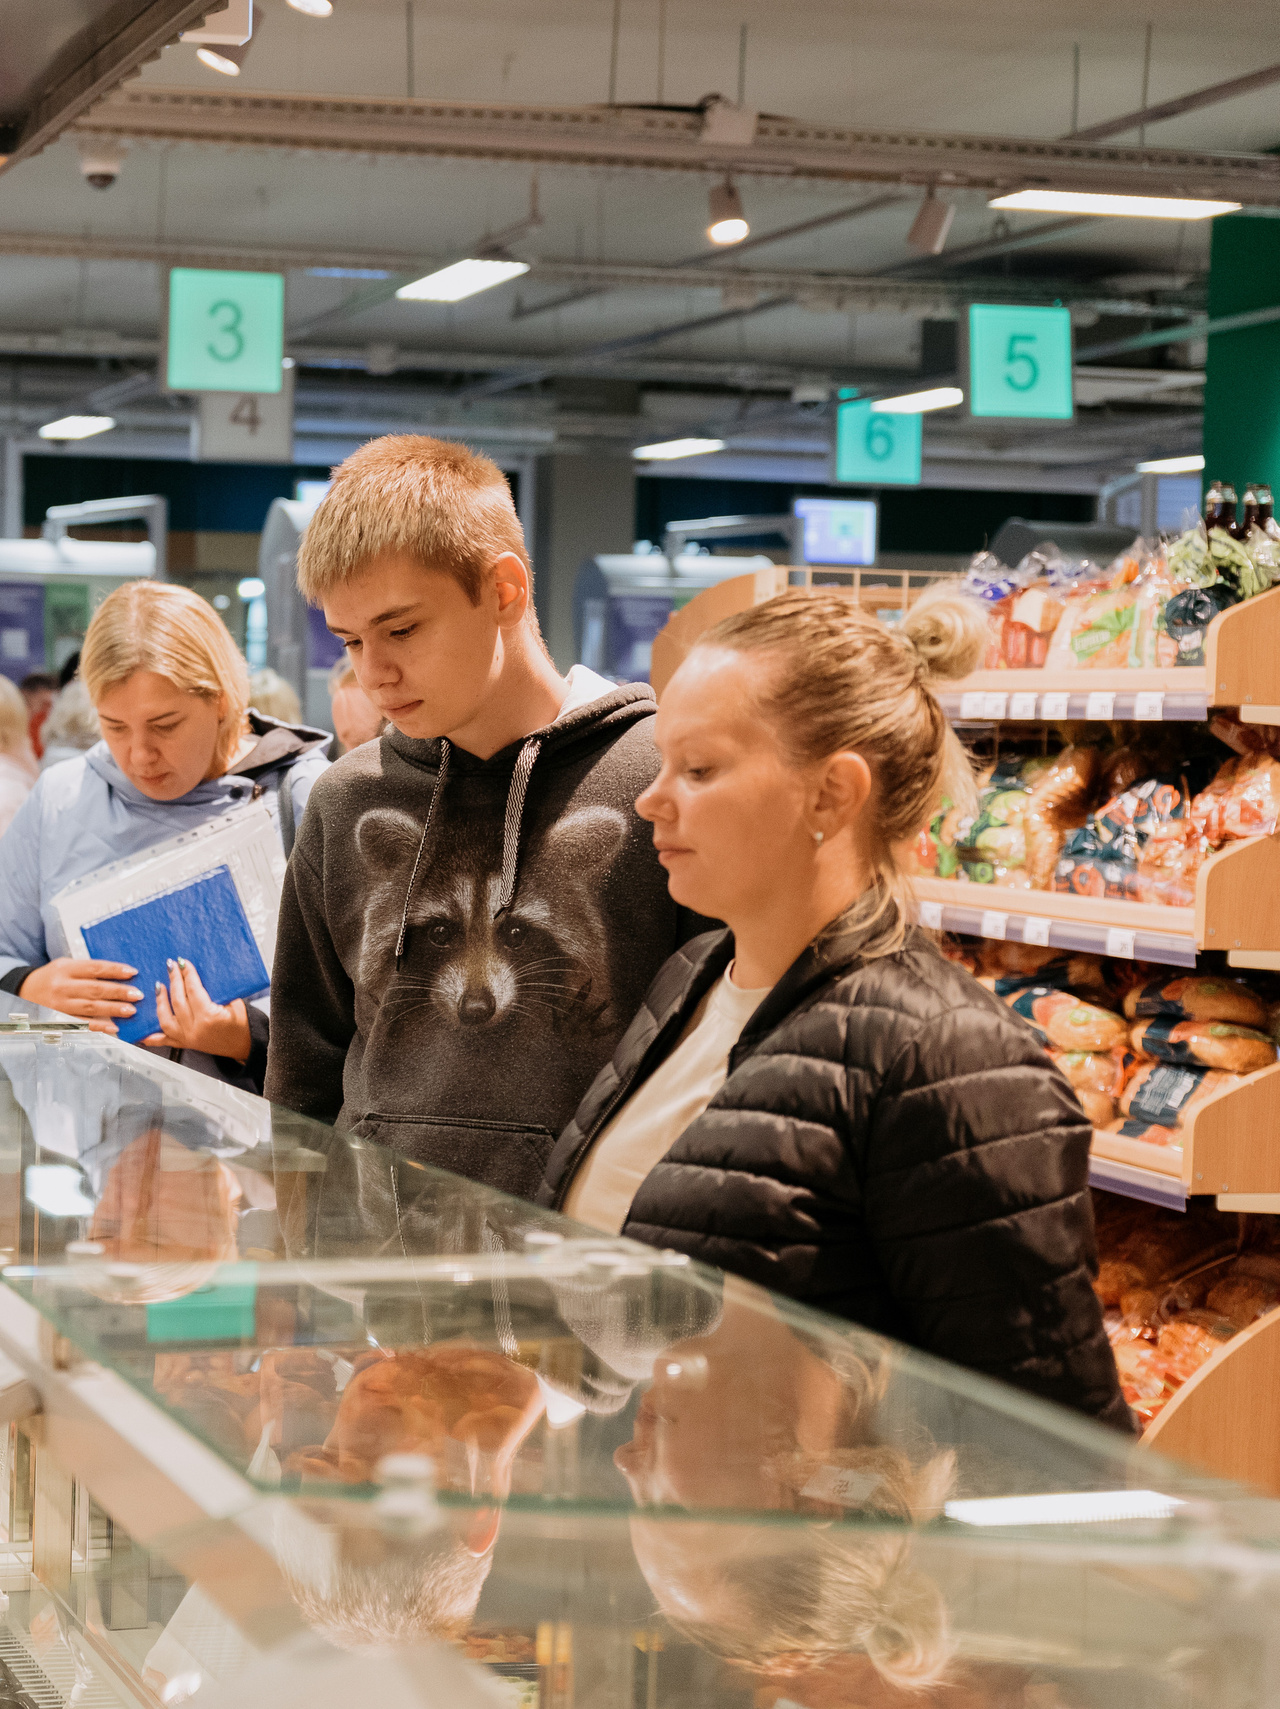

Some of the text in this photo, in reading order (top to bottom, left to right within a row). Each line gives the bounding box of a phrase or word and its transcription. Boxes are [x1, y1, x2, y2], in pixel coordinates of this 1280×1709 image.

[207, 299, 244, 362] 3
[1005, 333, 1039, 392] 5
[229, 393, 261, 435] 4
[865, 412, 895, 461] 6
